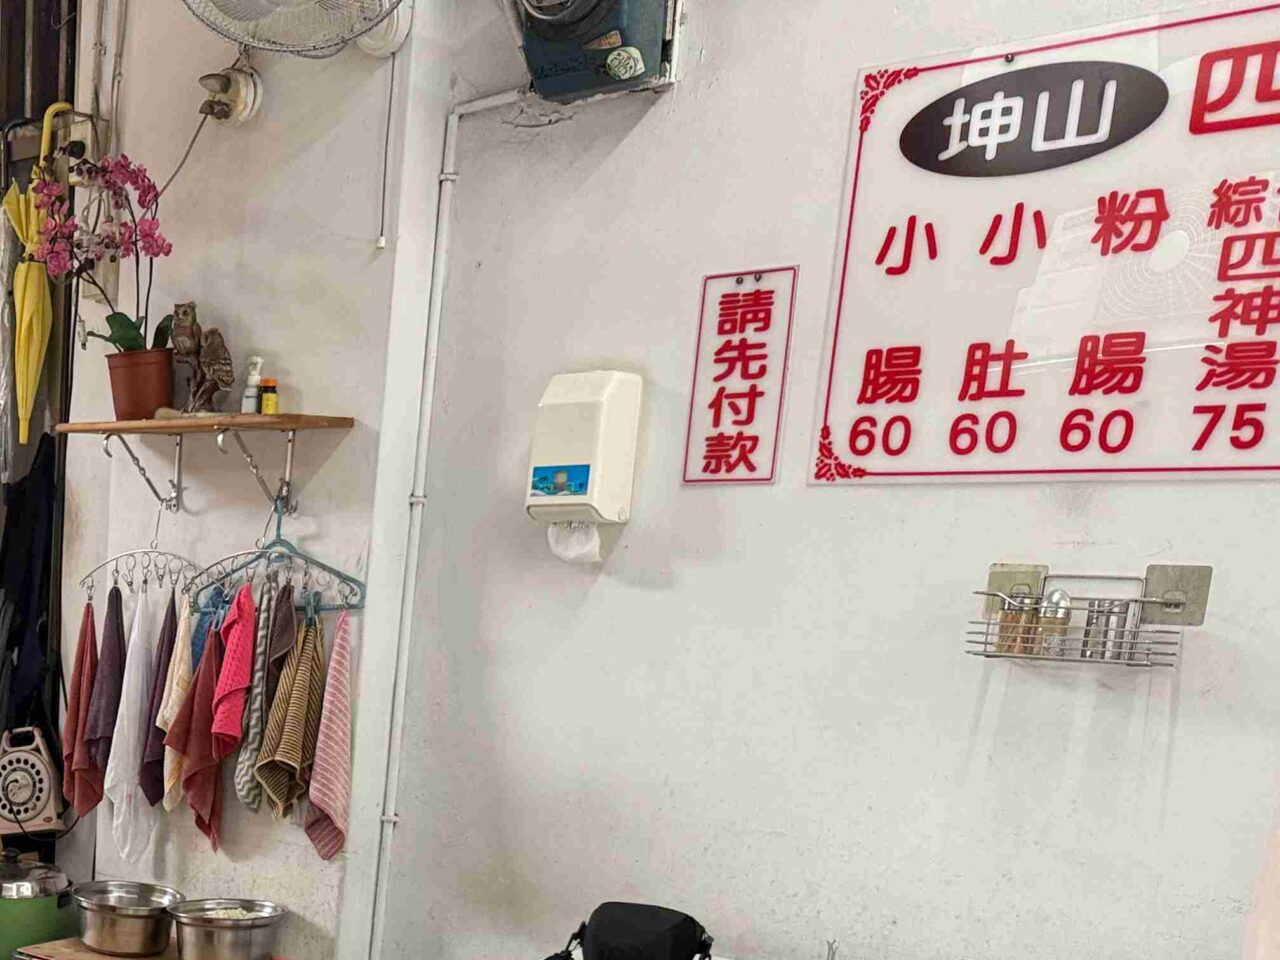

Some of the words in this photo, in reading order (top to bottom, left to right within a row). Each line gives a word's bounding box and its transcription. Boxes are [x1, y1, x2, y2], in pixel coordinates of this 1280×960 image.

[938, 79, 1117, 160] 坤山
[702, 289, 775, 476] 請先付款
[848, 416, 912, 456] 60
[949, 410, 1017, 456] 60
[1059, 408, 1135, 455] 60
[1191, 403, 1267, 451] 75
